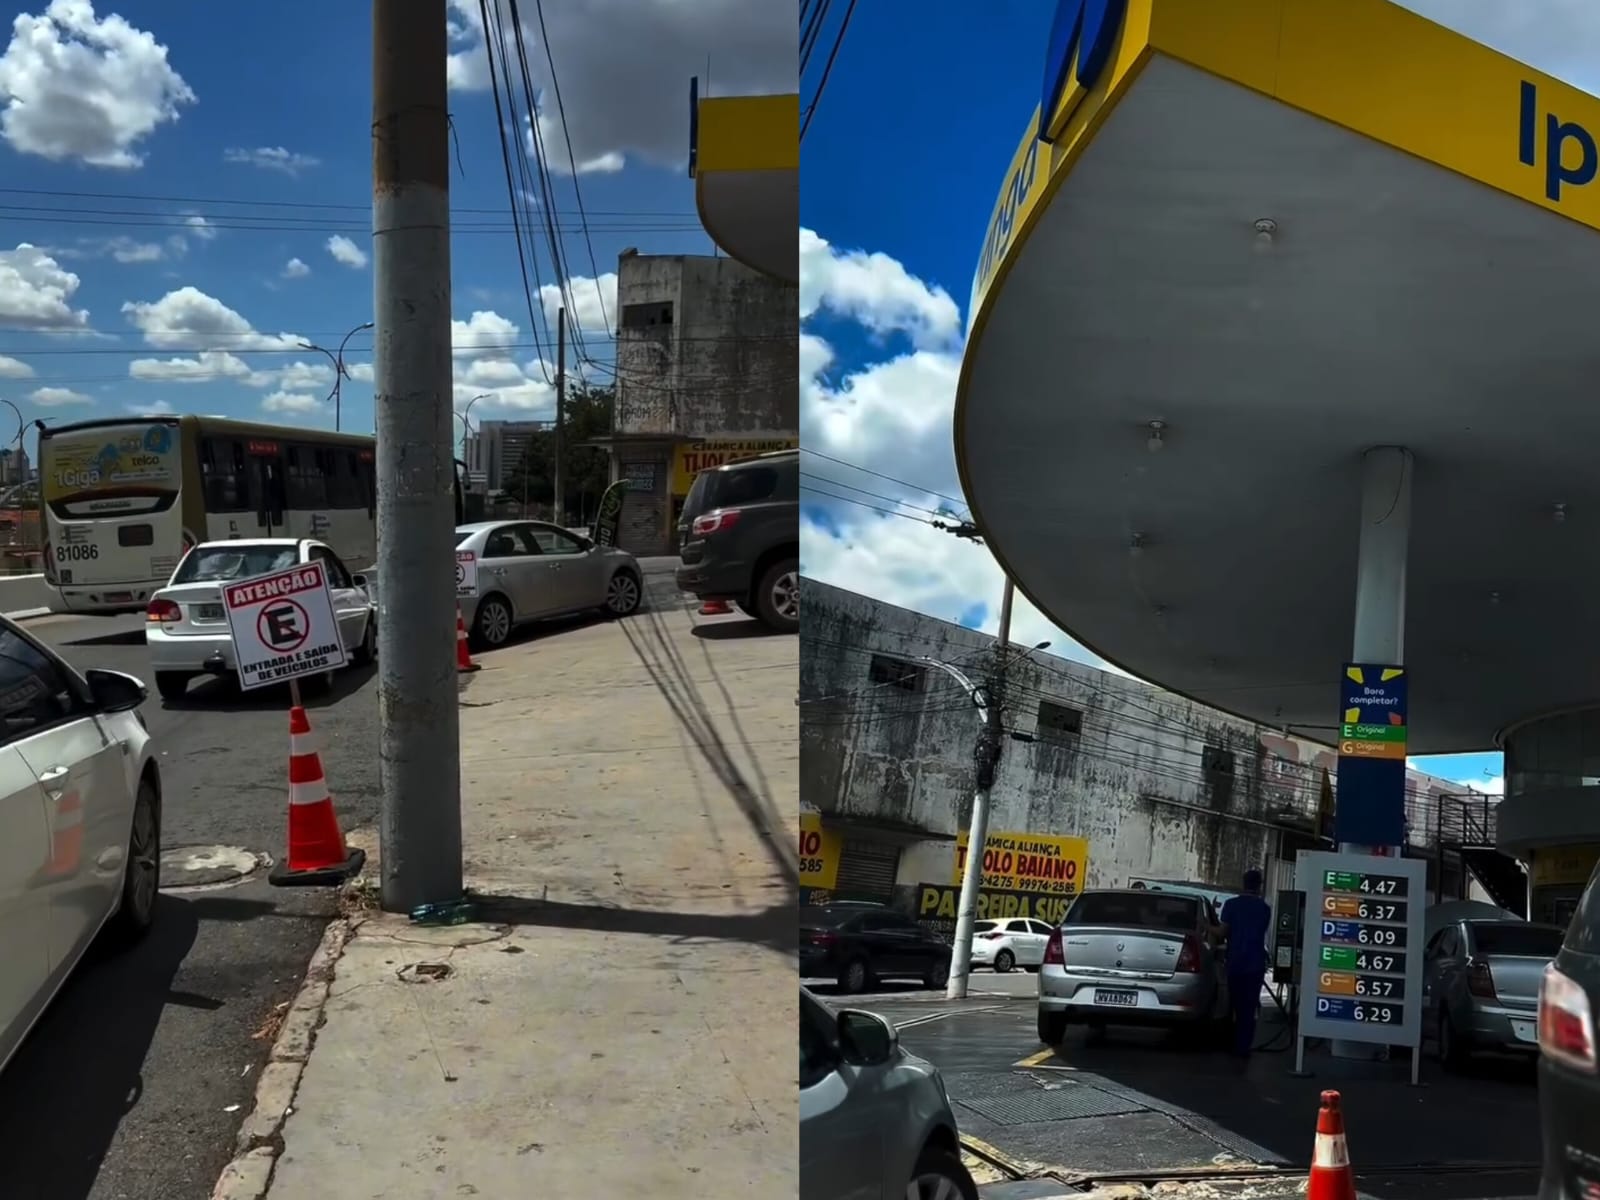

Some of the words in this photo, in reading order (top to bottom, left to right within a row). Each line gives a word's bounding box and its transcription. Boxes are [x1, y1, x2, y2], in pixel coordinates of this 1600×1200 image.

[1519, 80, 1598, 202] Ip
[56, 544, 98, 561] 81086
[233, 570, 318, 605] ATENÇÃO
[243, 655, 294, 674] ENTRADA
[295, 652, 303, 661] E
[304, 643, 339, 659] SAÍDA
[258, 670, 275, 680] DE
[273, 656, 328, 676] VEÍCULOS
[1349, 696, 1399, 706] completar?
[1344, 725, 1353, 737] E
[1356, 726, 1386, 735] Original
[1342, 741, 1353, 754] G
[1356, 743, 1385, 752] Original
[1017, 841, 1061, 857] ALIANÇA
[957, 846, 1013, 873] TOLO
[1016, 856, 1076, 880] BAIANO
[1326, 872, 1336, 885] E
[1360, 879, 1397, 894] 4,47
[920, 887, 1030, 921] PAREIRA
[1324, 897, 1336, 910] G
[1358, 904, 1396, 920] 6,37
[1323, 921, 1335, 935] D
[1358, 929, 1396, 945] 6,09
[1323, 947, 1332, 960] E
[1356, 954, 1394, 971] 4,67
[1321, 972, 1332, 986] G
[1355, 980, 1393, 996] 6,57
[1318, 998, 1329, 1012] D
[1354, 1006, 1392, 1022] 6,29
